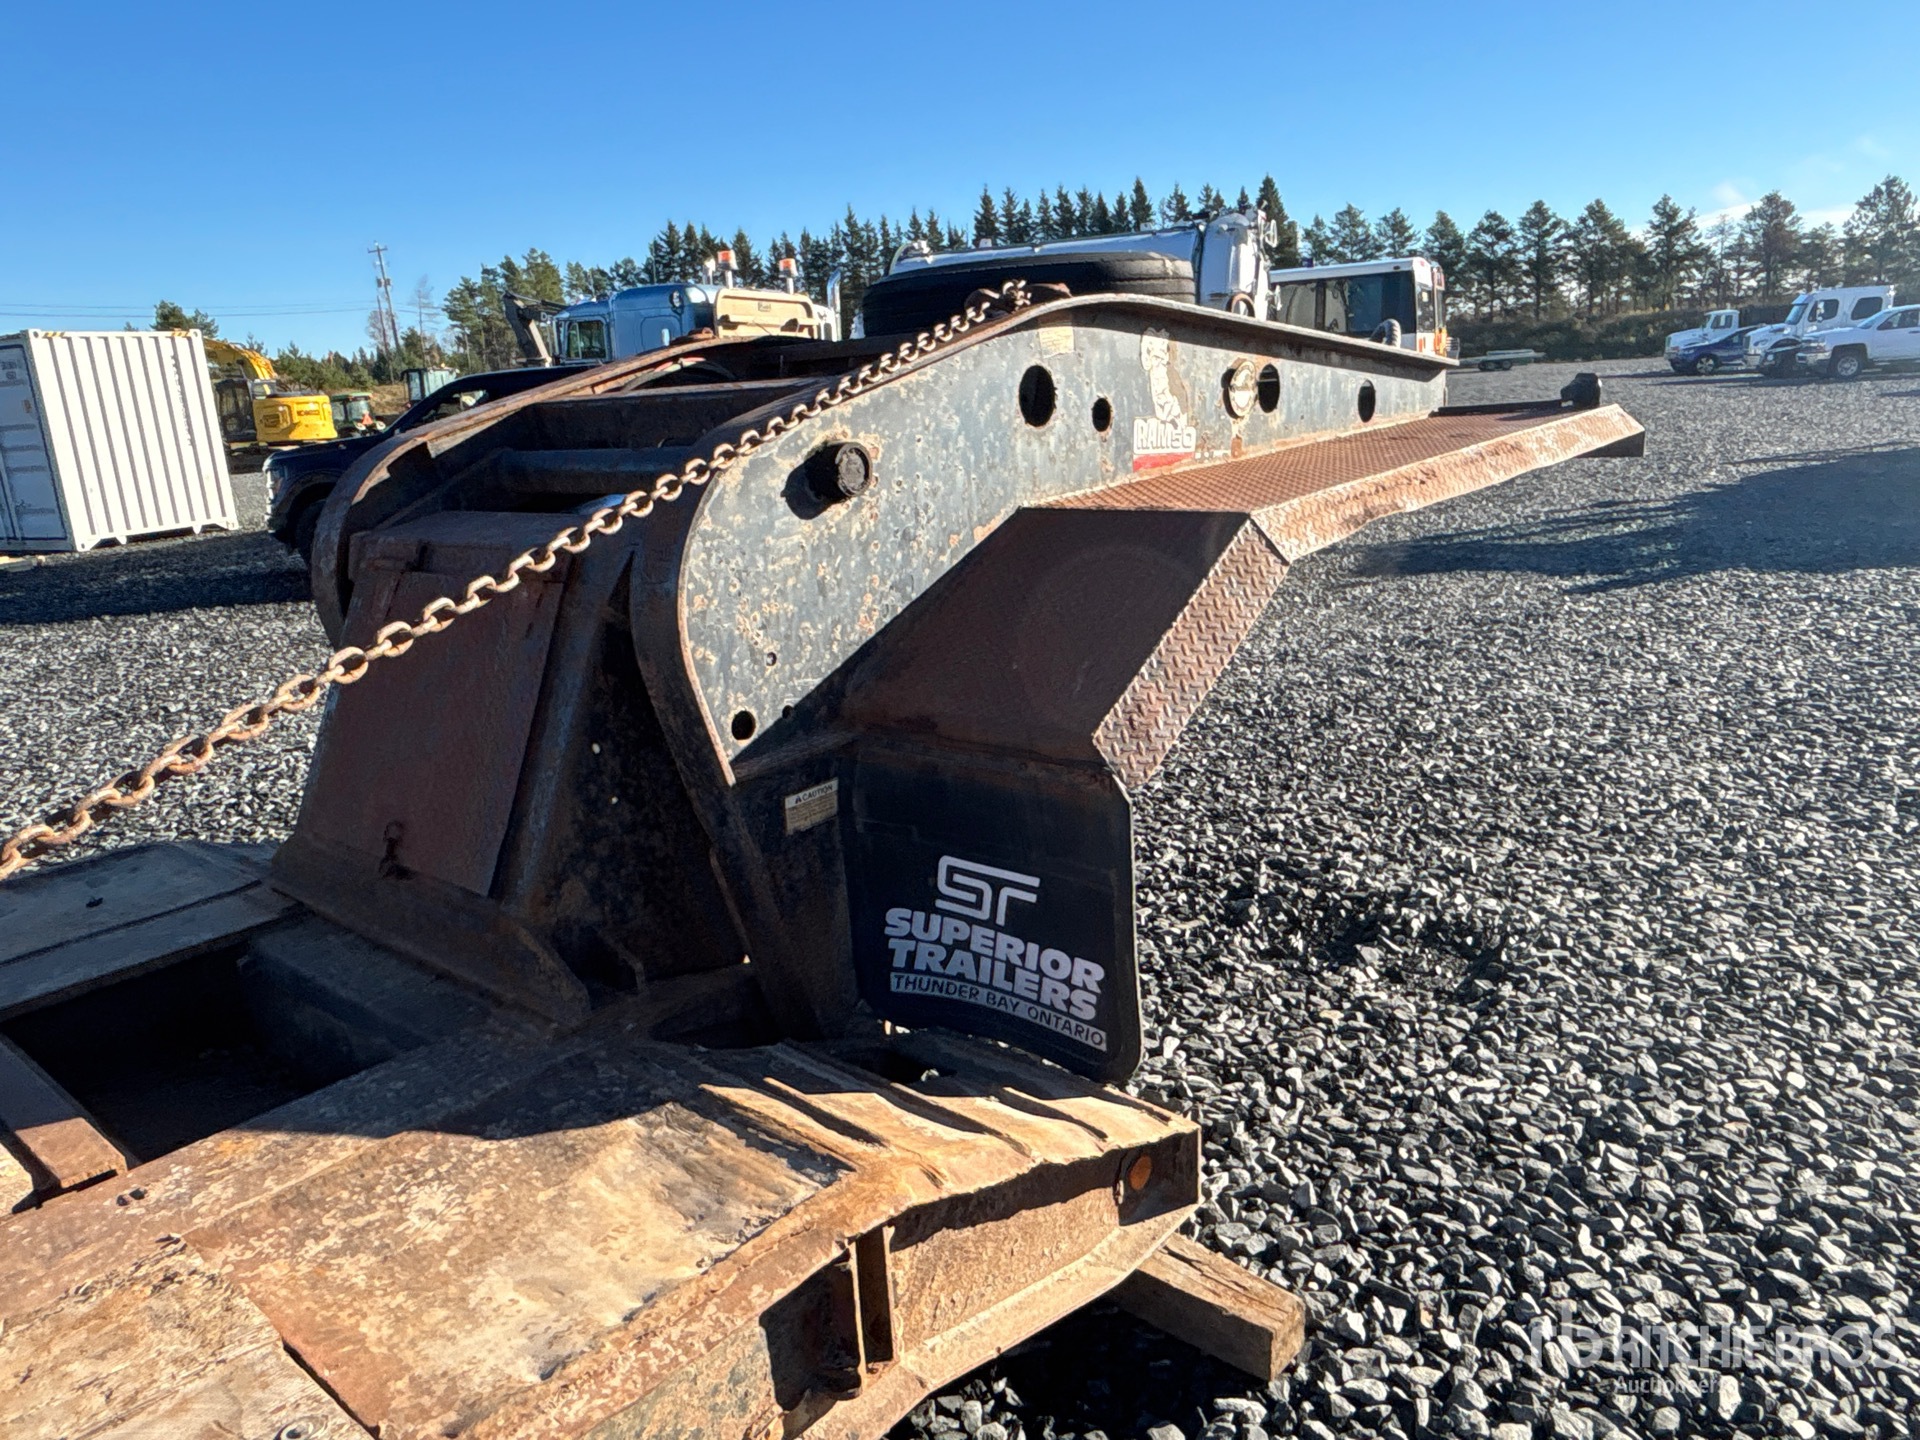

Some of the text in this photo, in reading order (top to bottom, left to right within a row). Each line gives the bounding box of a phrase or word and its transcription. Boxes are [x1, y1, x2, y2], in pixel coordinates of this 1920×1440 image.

[802, 784, 833, 802] CAUTION
[884, 907, 1105, 994] SUPERIOR
[888, 938, 1097, 1020] TRAILERS
[894, 974, 1104, 1047] THUNDER BAY ONTARIO
